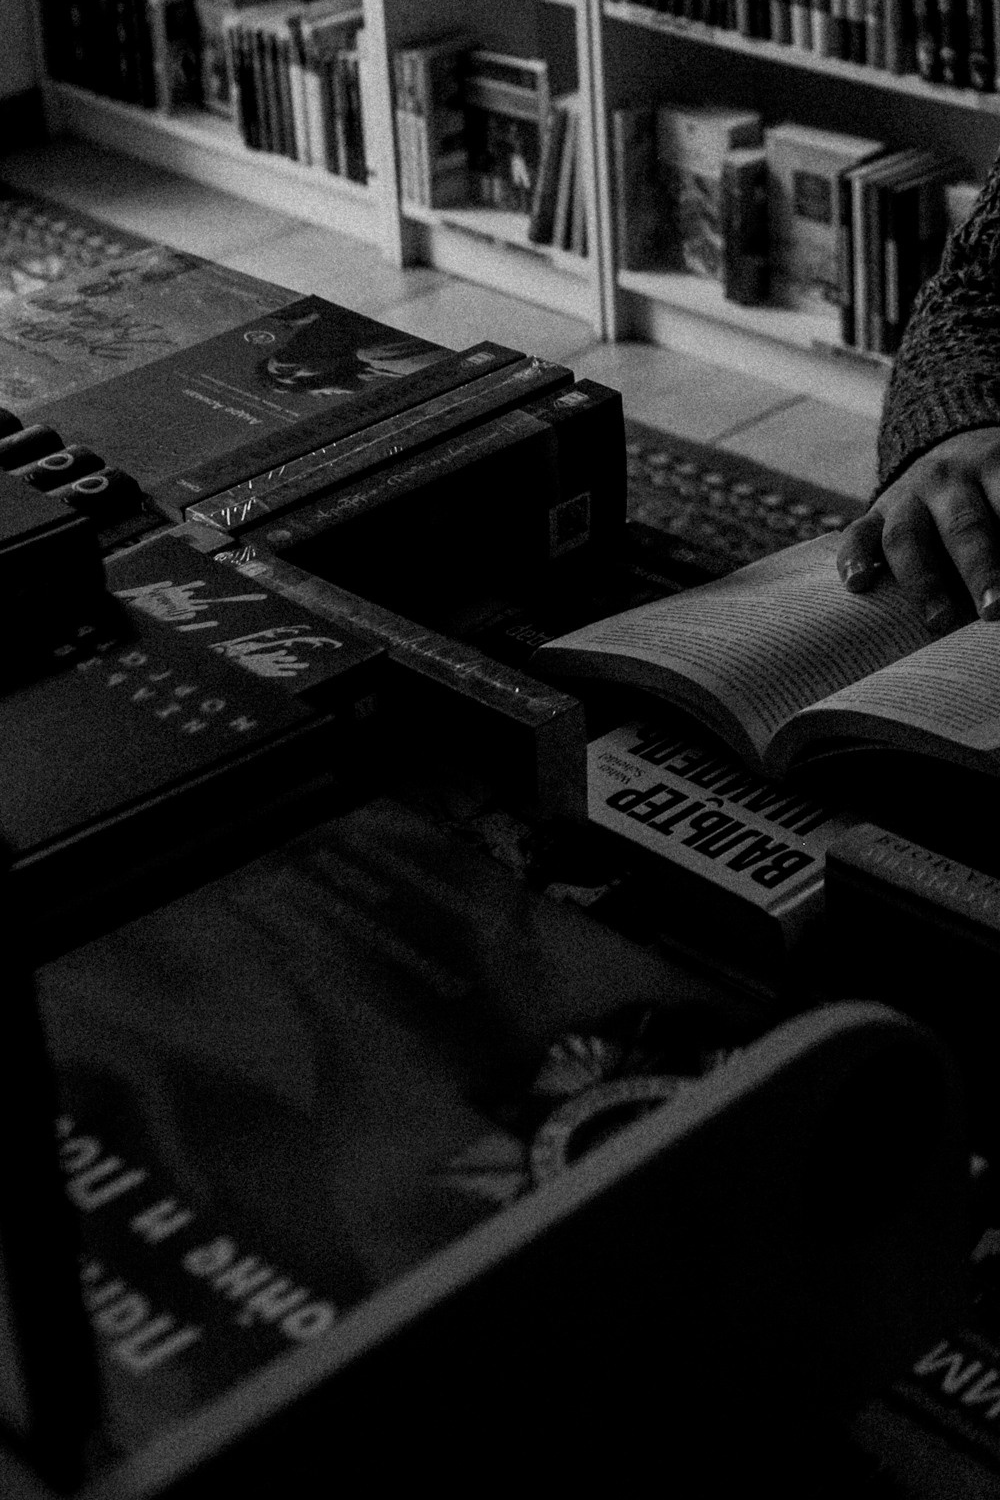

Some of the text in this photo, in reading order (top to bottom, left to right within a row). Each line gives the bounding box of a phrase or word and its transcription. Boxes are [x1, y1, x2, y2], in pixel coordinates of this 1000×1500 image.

[604, 783, 814, 891] ВАЛЬТЕР
[52, 1115, 150, 1214] По
[178, 1233, 338, 1347] ойне
